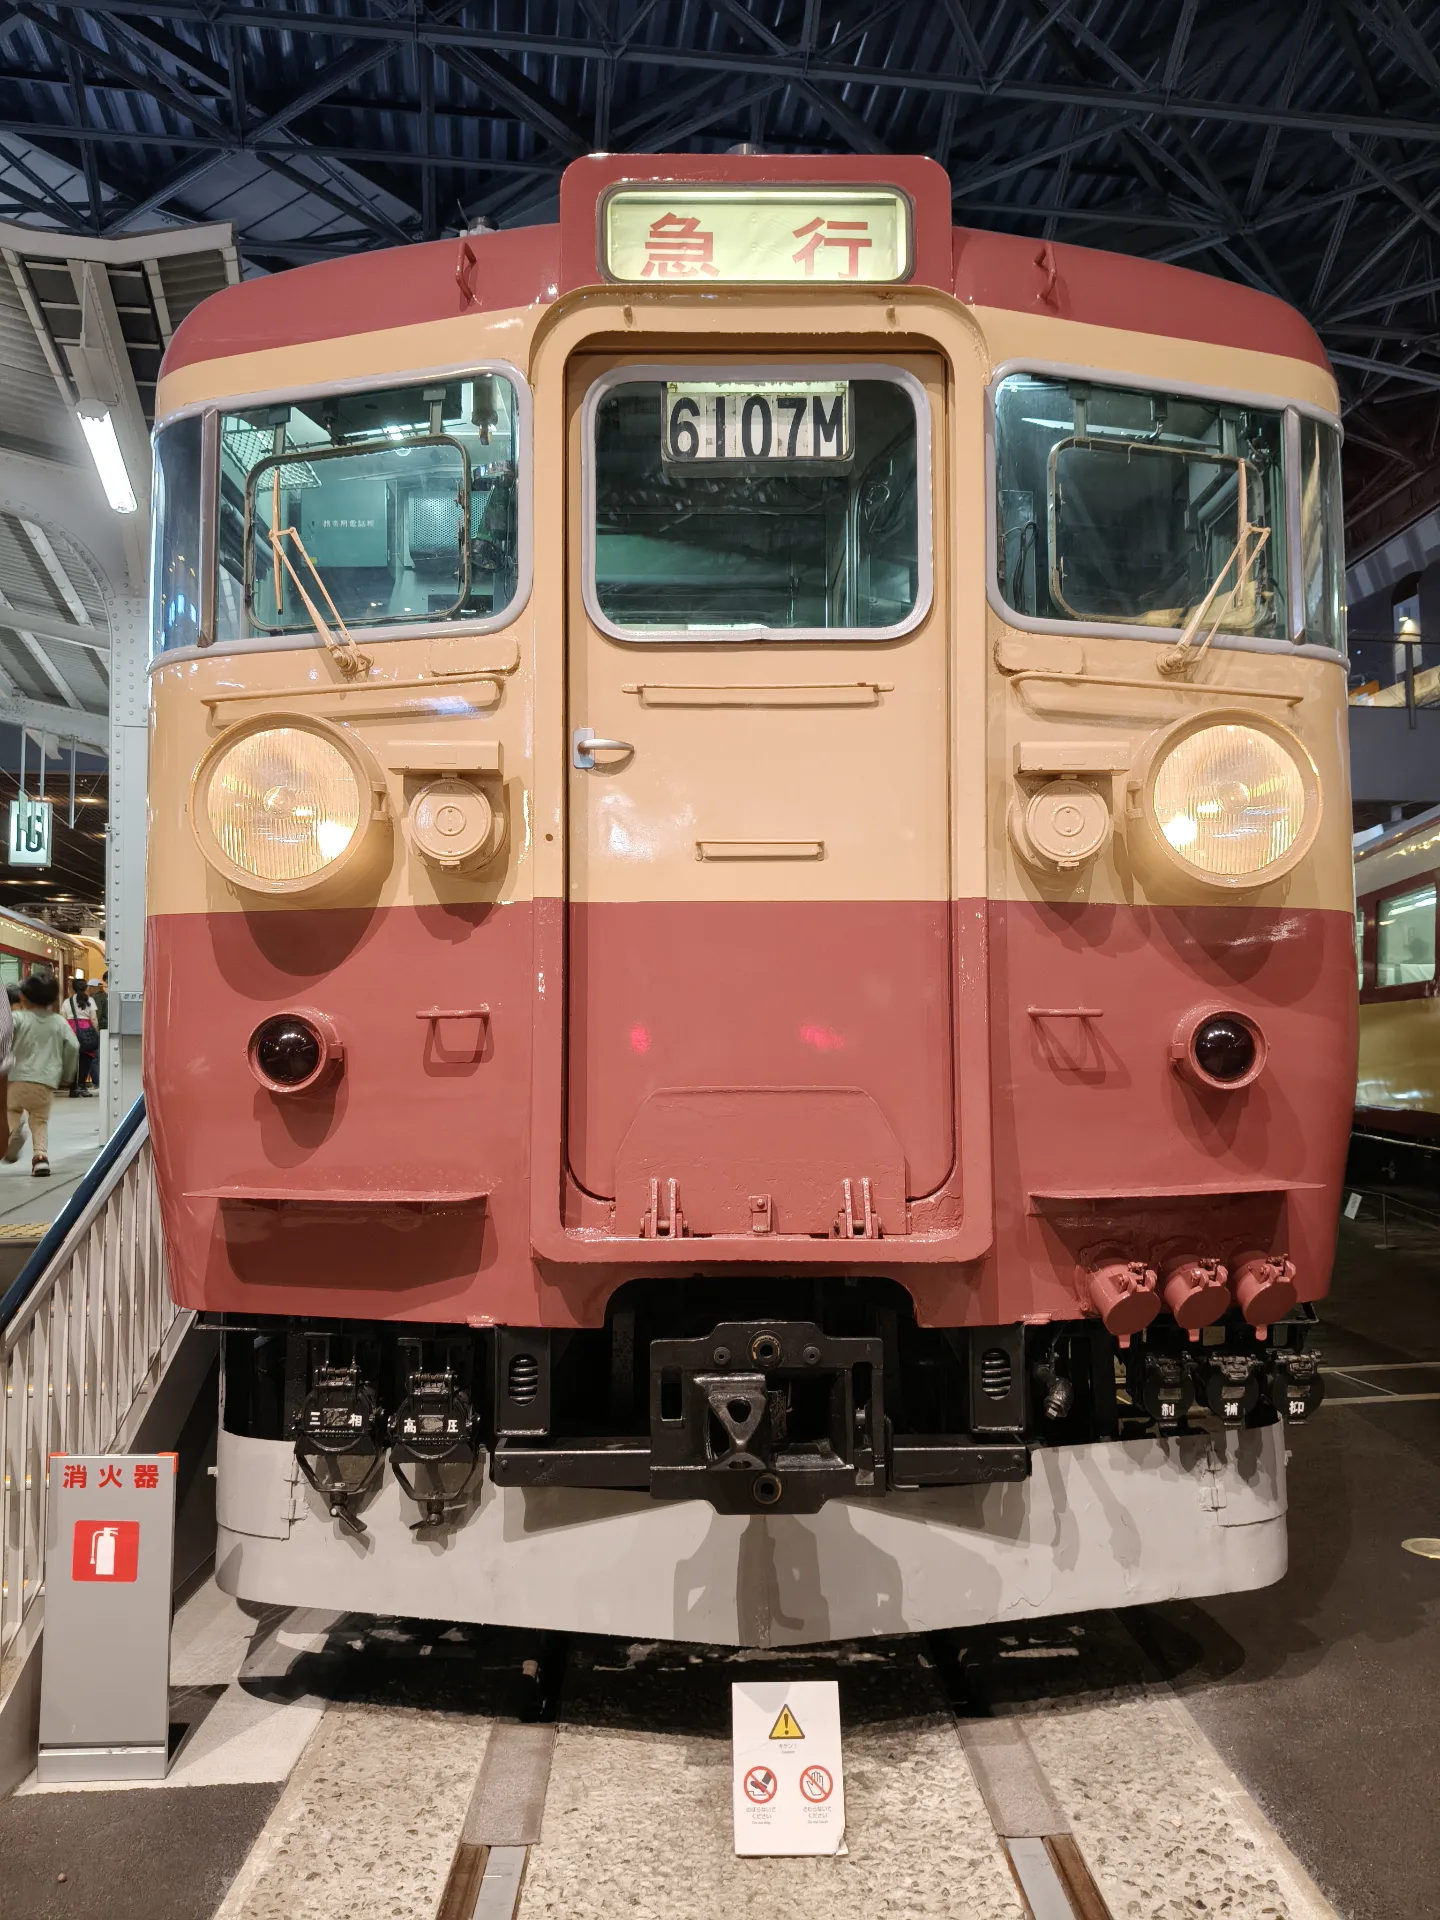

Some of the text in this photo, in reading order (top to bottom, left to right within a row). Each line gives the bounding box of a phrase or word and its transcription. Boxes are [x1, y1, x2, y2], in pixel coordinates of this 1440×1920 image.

[640, 212, 872, 279] 急行
[669, 394, 844, 458] 6107M
[1224, 1402, 1239, 1417] 補
[403, 1417, 459, 1434] 高圧
[62, 1464, 159, 1489] 消火器
